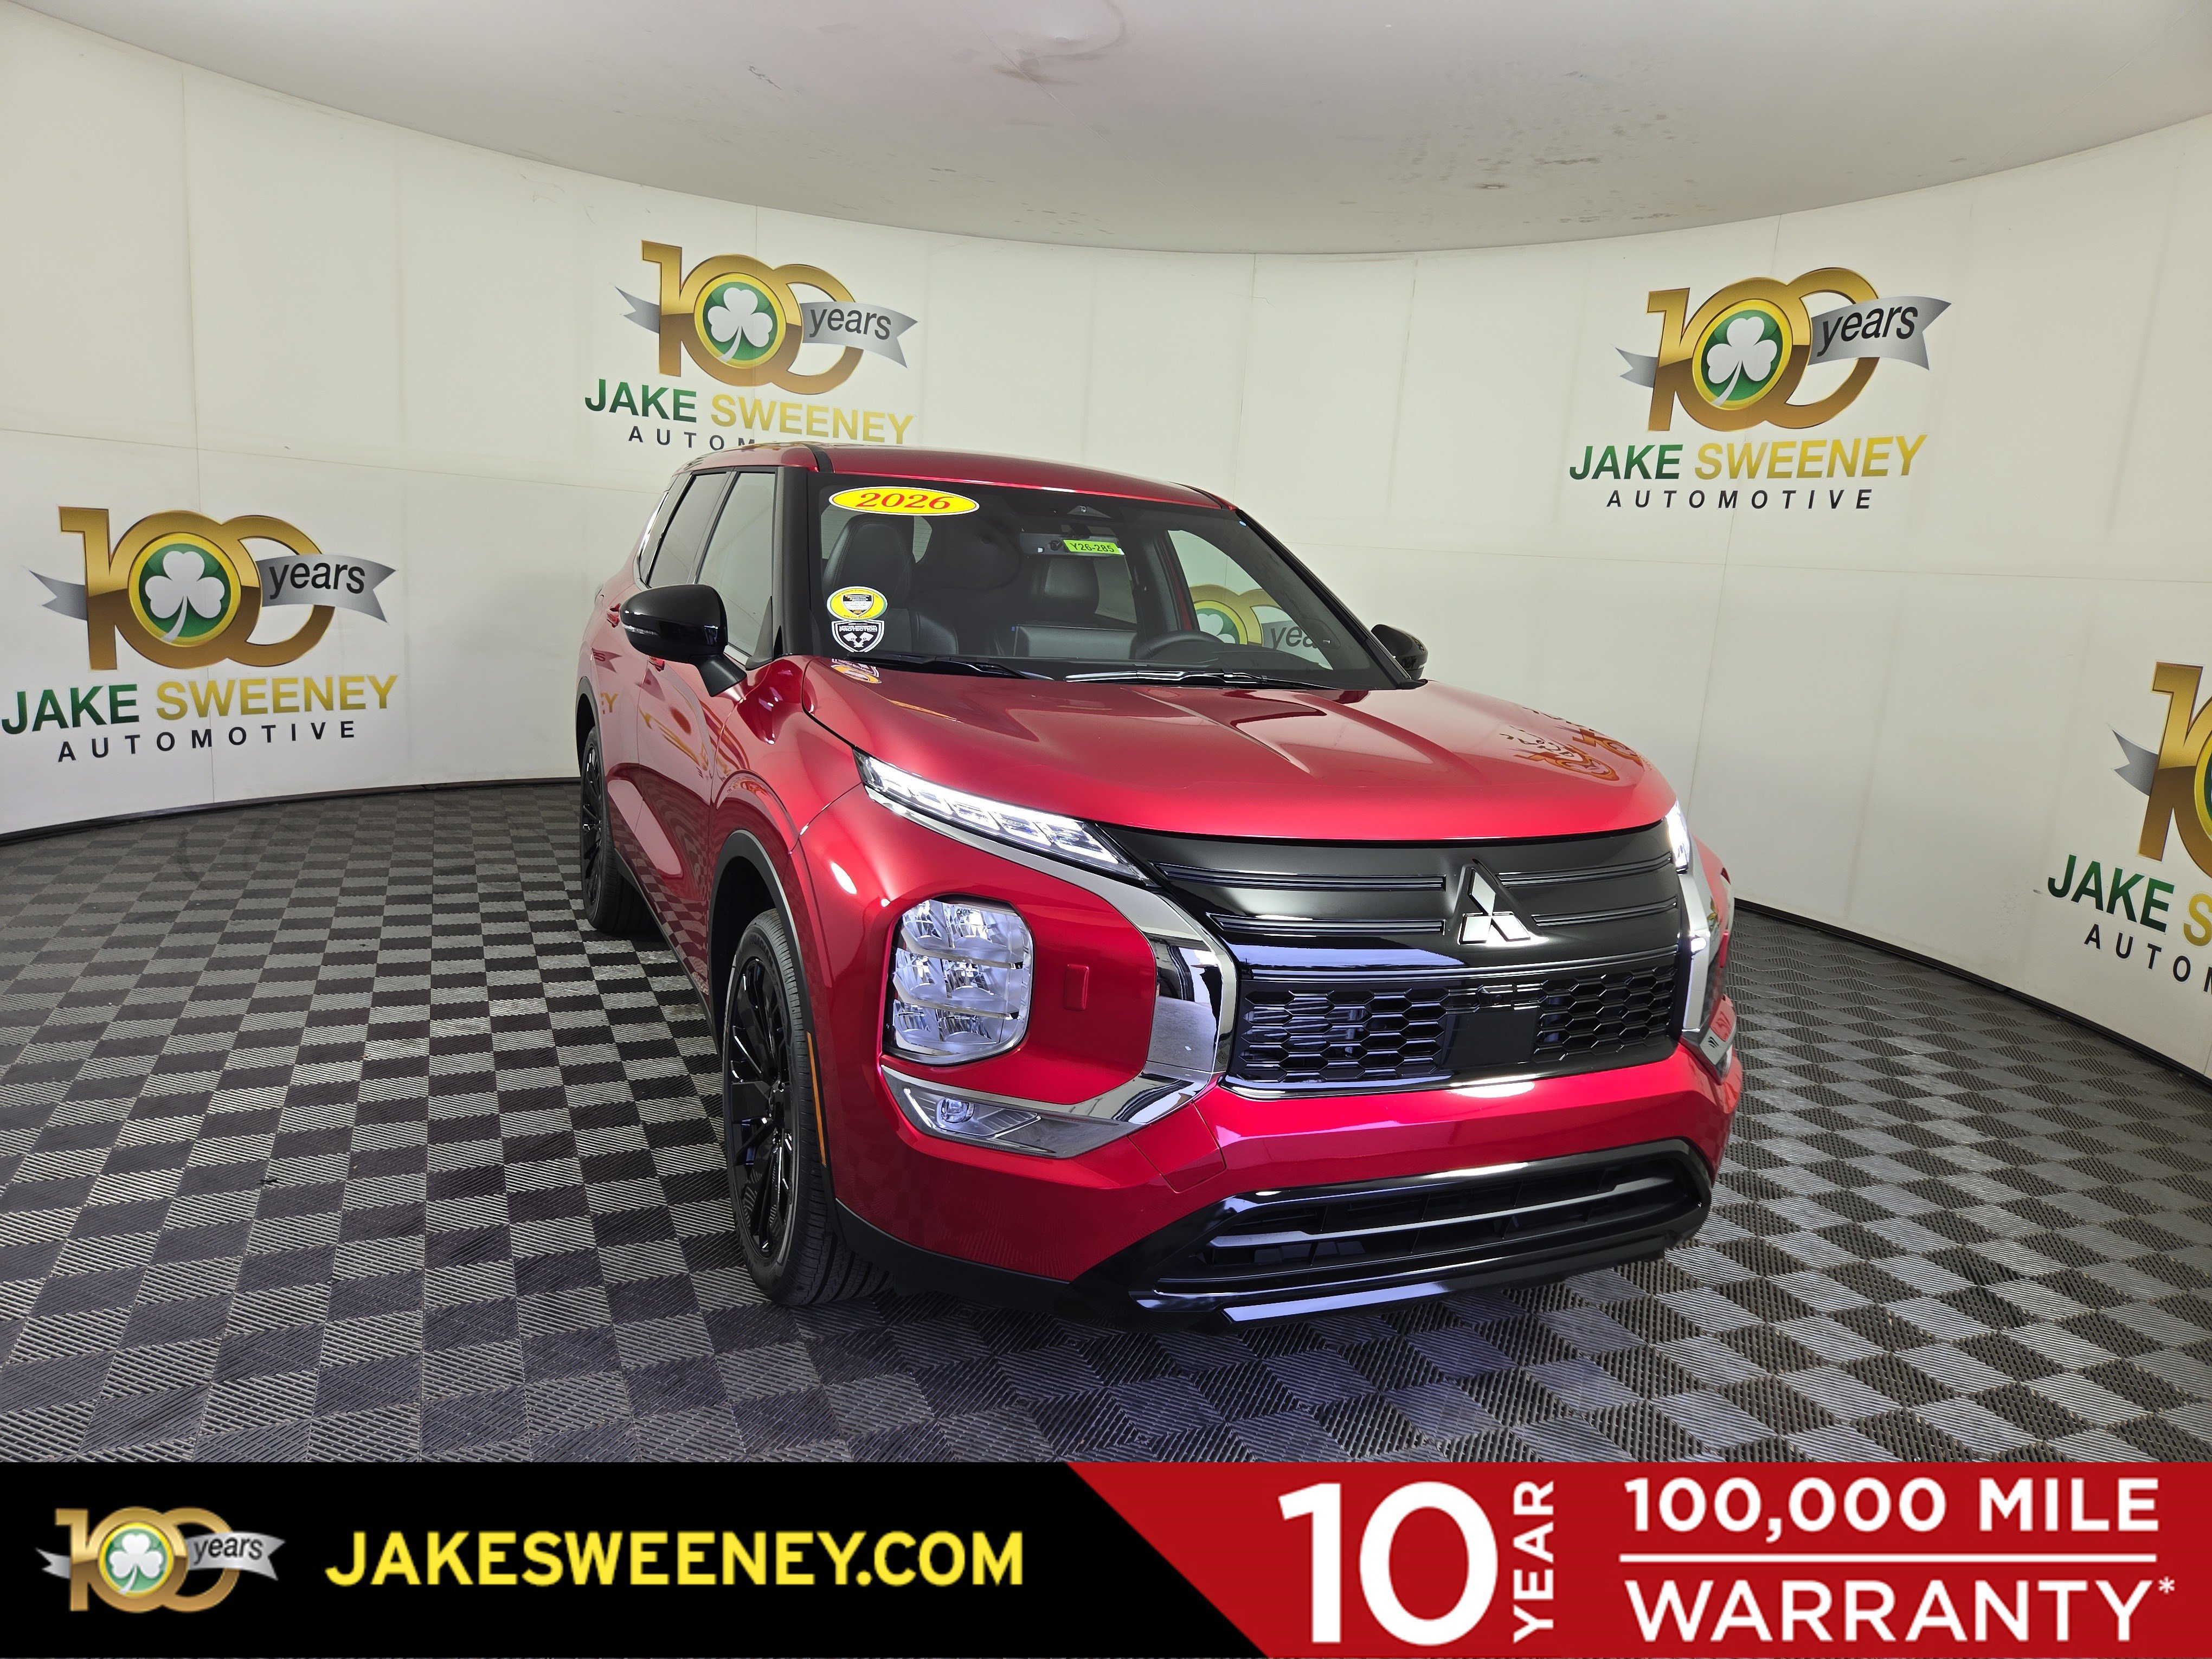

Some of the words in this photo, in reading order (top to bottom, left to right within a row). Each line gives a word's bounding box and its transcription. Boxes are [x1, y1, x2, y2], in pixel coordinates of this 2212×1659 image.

[641, 240, 864, 395] 100
[809, 305, 892, 340] years
[1647, 266, 1881, 432] 100
[1816, 305, 1918, 358] years
[584, 378, 697, 423] JAKE
[711, 394, 916, 445] SWEENEY
[1570, 443, 1682, 480] JAKE
[1695, 434, 1928, 480] SWEENEY
[856, 492, 954, 510] 2026
[1606, 489, 1872, 510] AUTOMOTIVE
[1070, 542, 1115, 552] Y26-285
[58, 506, 336, 671] 100
[269, 561, 366, 600] years
[1270, 626, 1319, 651] yea
[1, 683, 140, 735] JAKE
[156, 674, 398, 721] SWEENEY
[57, 721, 355, 763] AUTOMOTIVE
[2047, 854, 2175, 933] JAKE
